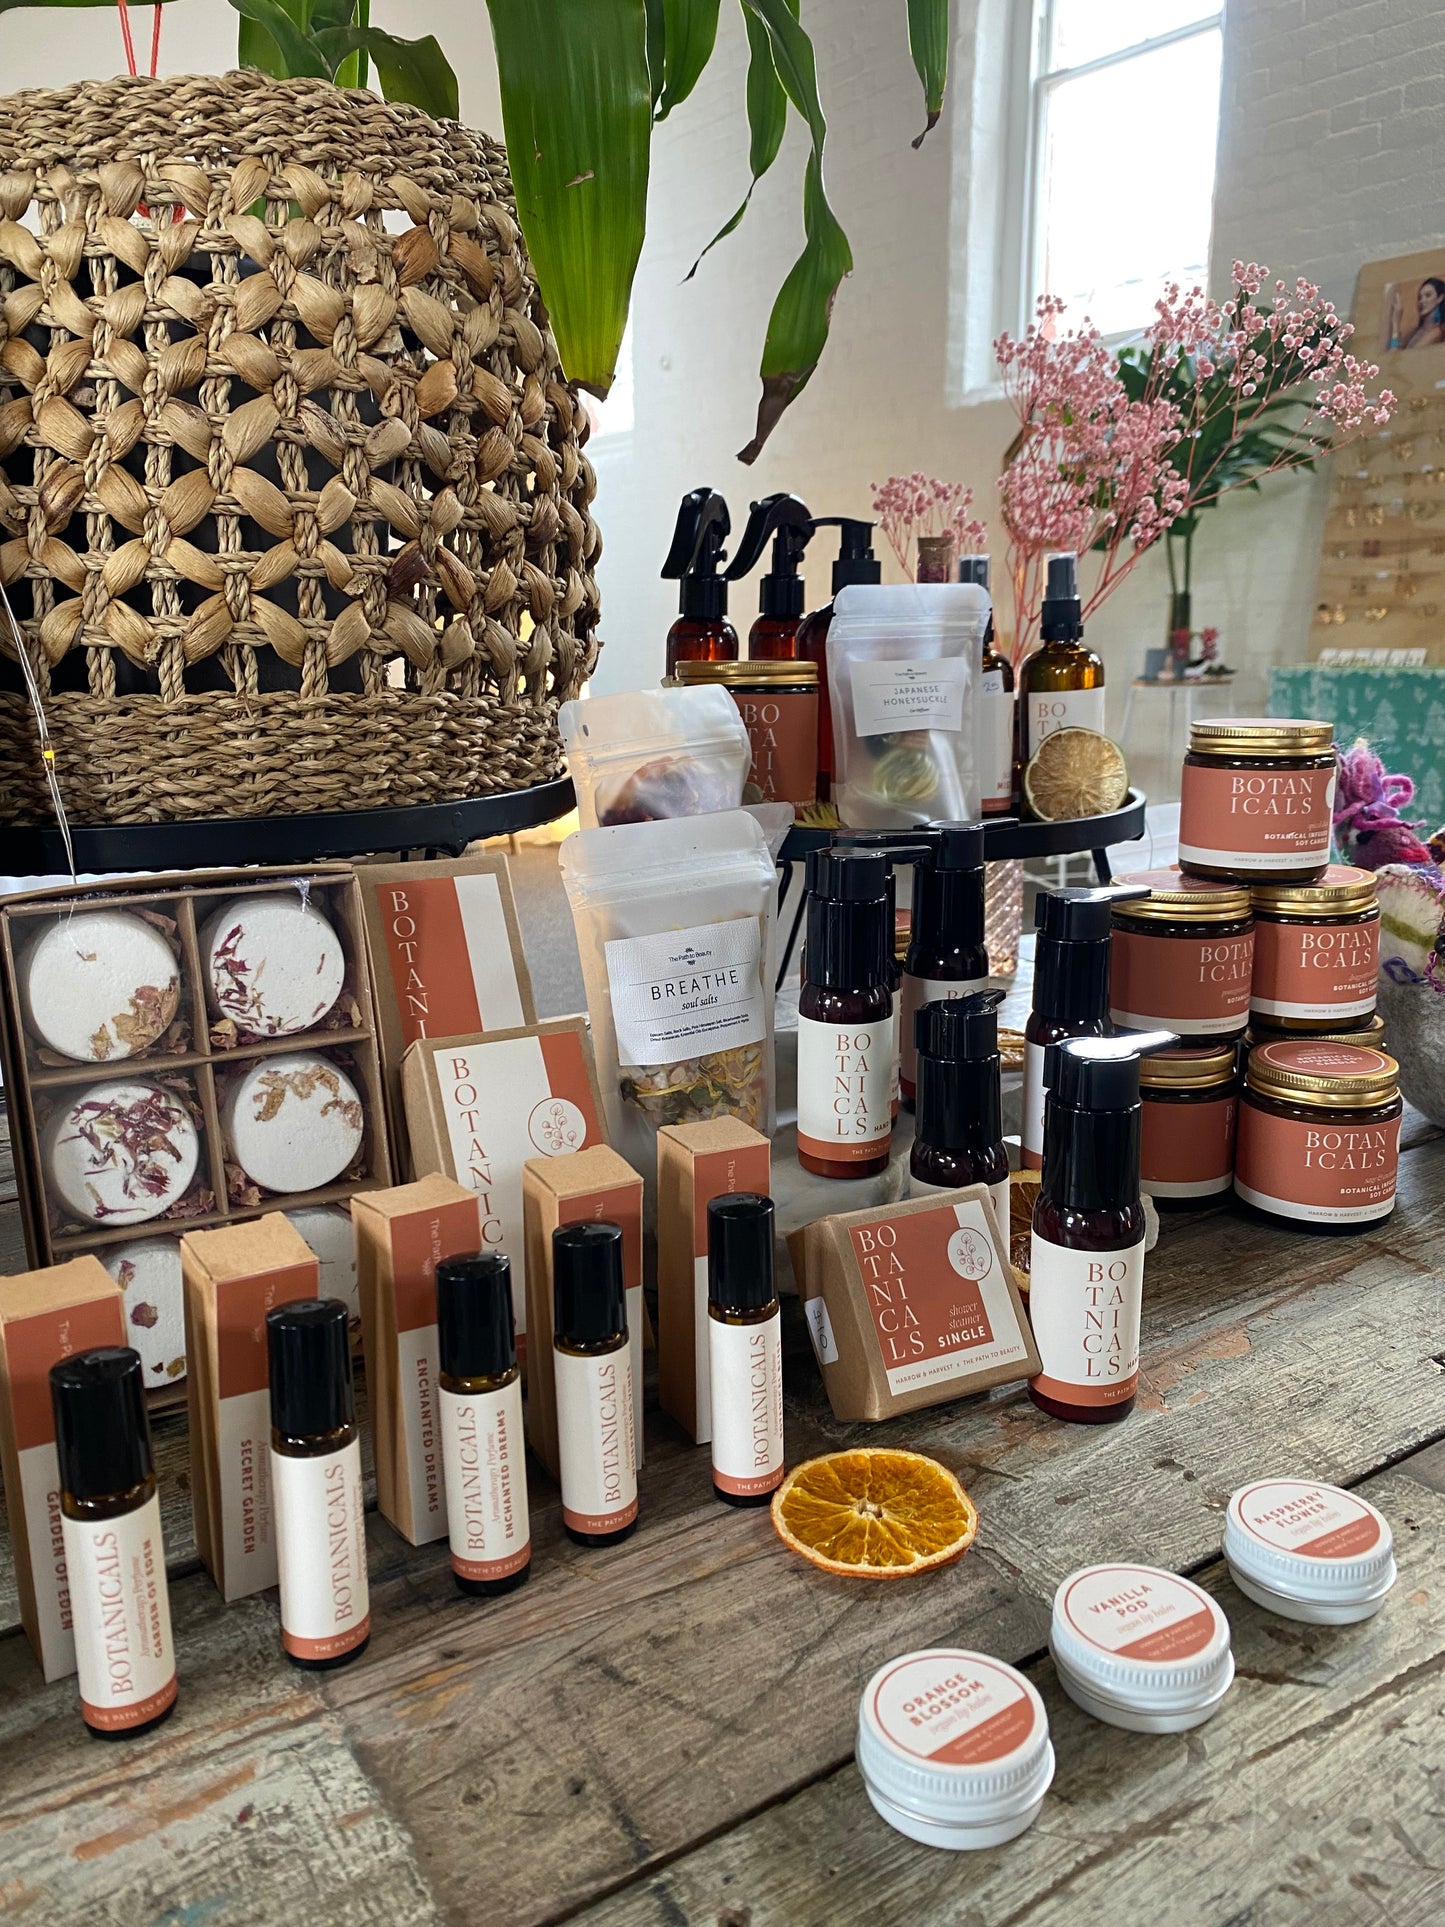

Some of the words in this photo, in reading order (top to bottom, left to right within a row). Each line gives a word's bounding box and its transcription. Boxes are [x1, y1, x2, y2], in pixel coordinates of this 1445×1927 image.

[883, 695, 948, 706] HONEYSUCKLE
[894, 685, 940, 695] JAPANESE
[743, 703, 780, 724] BO
[1038, 703, 1067, 718] BO
[1231, 777, 1314, 795] BOTAN
[1230, 797, 1312, 815] ICALS
[1264, 832, 1307, 840] BOTANICAL
[1295, 839, 1308, 847] SOY
[1301, 928, 1373, 950] BOTAN
[695, 950, 712, 958] Beauty
[1300, 947, 1372, 969] ICALS
[651, 970, 739, 1001] BREATHE
[682, 996, 699, 1010] soul
[700, 993, 718, 1006] salts
[837, 1033, 871, 1052] BO
[835, 1055, 870, 1073] TA
[834, 1075, 867, 1094] NI
[833, 1097, 869, 1115] CA
[836, 1117, 867, 1136] LS
[1305, 1130, 1388, 1150] BOTAN
[1304, 1150, 1386, 1170] ICALS
[1340, 1184, 1380, 1194] BOTANICAL
[1370, 1191, 1381, 1199] SOY
[430, 1218, 441, 1240] The
[857, 1225, 897, 1253] BO
[864, 1251, 906, 1279] TA
[1087, 1261, 1128, 1283] BO
[870, 1277, 909, 1307] NI
[1085, 1285, 1125, 1307] TA
[879, 1304, 920, 1333] CA
[949, 1301, 978, 1317] shower
[1084, 1309, 1121, 1330] NI
[812, 1309, 828, 1349] $10
[949, 1312, 982, 1330] steamer
[888, 1330, 925, 1361] LS
[938, 1325, 986, 1348] SINGLE
[1083, 1333, 1123, 1354] CA
[895, 1373, 921, 1384] HARROW
[928, 1364, 954, 1375] HARVEST
[963, 1358, 974, 1366] THE
[975, 1353, 990, 1362] PATH
[991, 1351, 999, 1359] TO
[1000, 1345, 1020, 1356] BEAUTY
[1085, 1355, 1121, 1377] LS
[416, 1358, 434, 1449] ENCHANTED
[749, 1333, 770, 1468] BOTANICALS
[496, 1409, 509, 1461] DREAMS
[598, 1364, 621, 1504] BOTANICALS
[241, 1439, 254, 1491] SECRET
[424, 1452, 439, 1513] DREAMS
[456, 1405, 485, 1551] BOTANICALS
[737, 1482, 751, 1491] THE
[753, 1480, 771, 1489] PATH
[500, 1464, 514, 1539] ENCHANTED
[1254, 1491, 1324, 1525] RASPBERRY
[46, 1491, 66, 1560] GARDEN
[242, 1496, 256, 1554] GARDEN
[587, 1520, 602, 1528] THE
[604, 1516, 623, 1527] PATH
[1275, 1502, 1328, 1528] FLOWER
[325, 1464, 353, 1623] BOTANICALS
[143, 1539, 156, 1577] EDEN
[468, 1566, 489, 1575] PATH
[490, 1565, 503, 1574] TO
[504, 1553, 529, 1571] BEAUTY
[56, 1563, 69, 1586] OF
[147, 1580, 157, 1599] OF
[1088, 1584, 1153, 1615] VANILLA
[57, 1588, 73, 1631] EDEN
[93, 1532, 133, 1695] BOTANICALS
[1116, 1600, 1149, 1618] POD
[150, 1602, 163, 1659] GARDEN
[314, 1645, 332, 1653] THE
[903, 1672, 968, 1713] ORANGE
[909, 1679, 985, 1727] BLOSSOM
[112, 1710, 138, 1722] PATH
